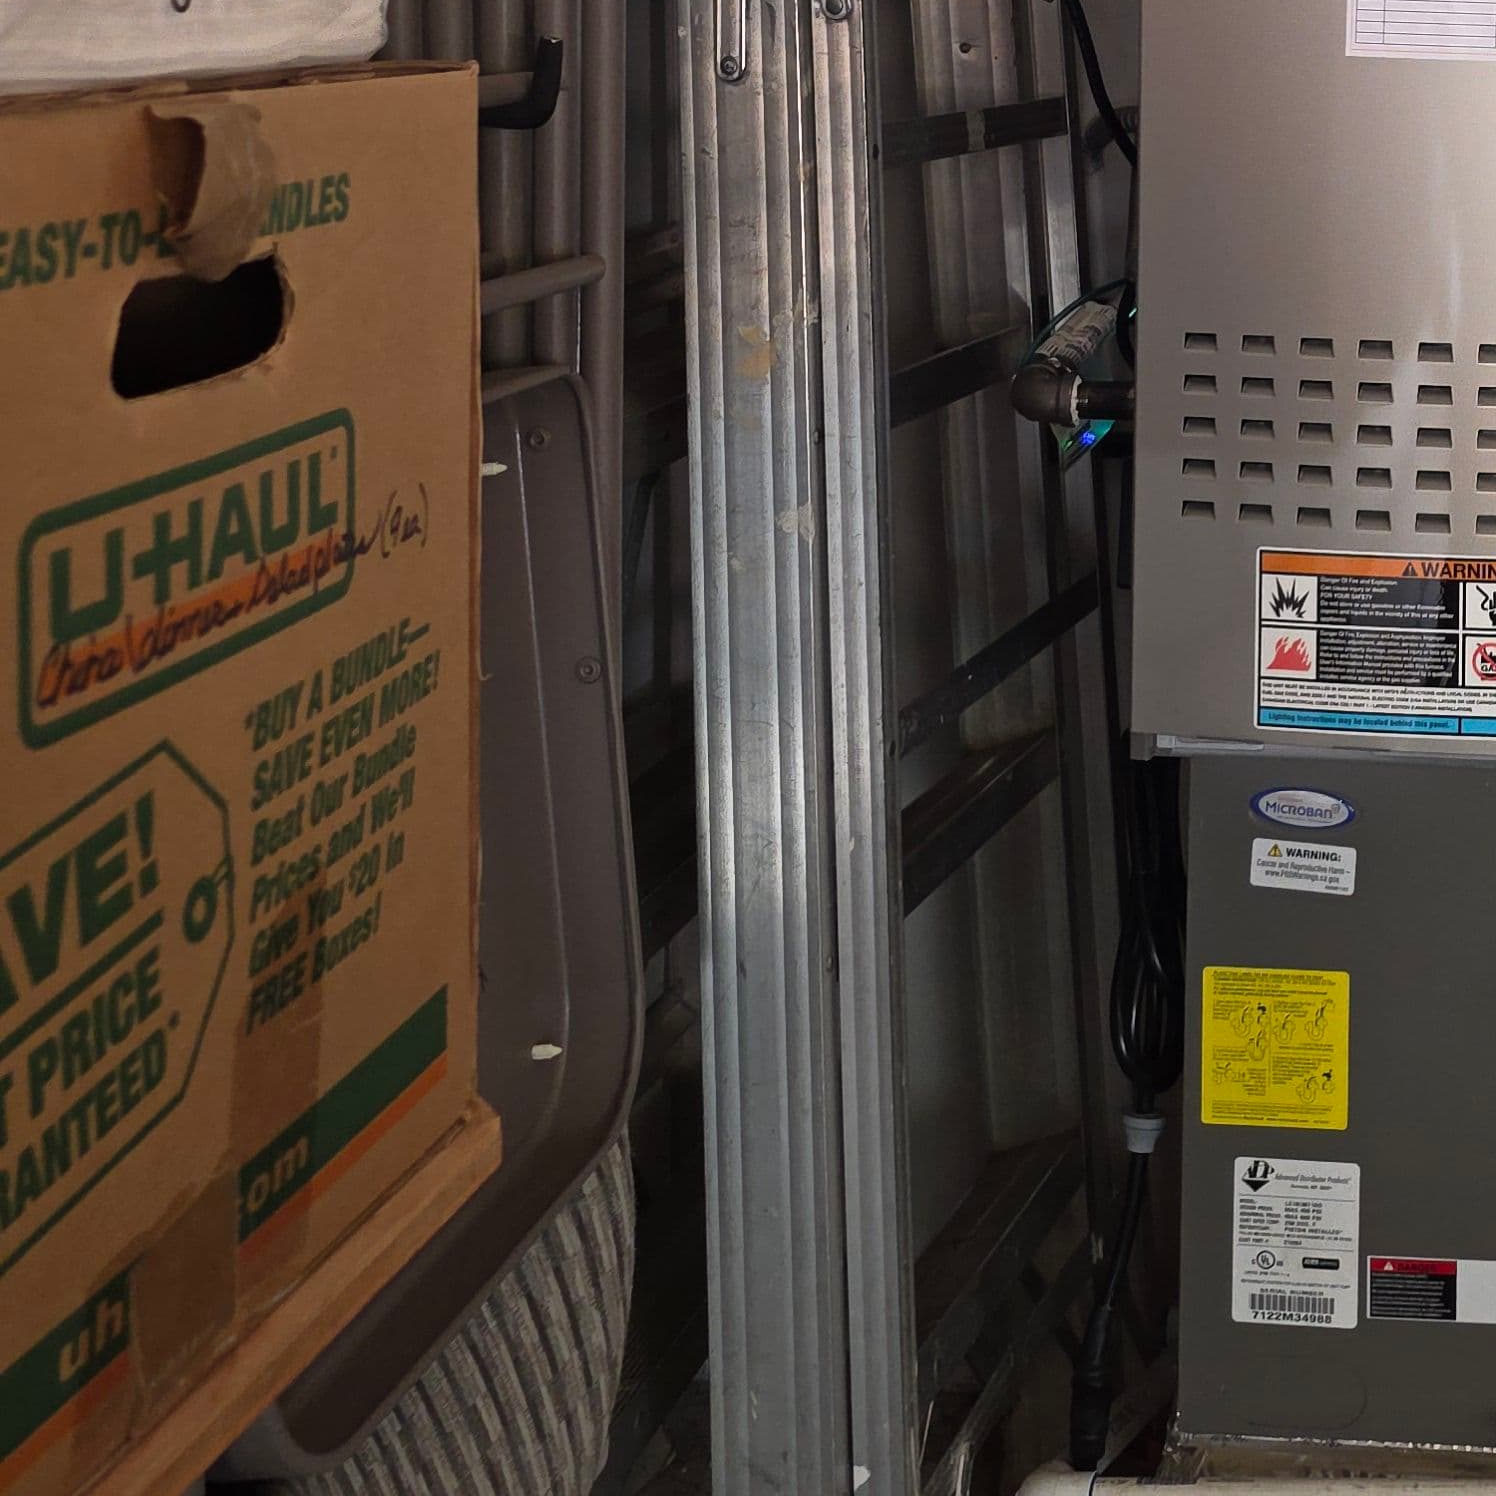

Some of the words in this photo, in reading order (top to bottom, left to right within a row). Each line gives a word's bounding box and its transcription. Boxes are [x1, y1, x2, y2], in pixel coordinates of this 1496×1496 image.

[251, 730, 315, 812] SAVE
[320, 692, 376, 769] EVEN
[378, 648, 441, 729] MORE!
[307, 669, 324, 721] A
[250, 844, 322, 925] Prices
[326, 801, 367, 869] and
[251, 794, 305, 867] Beat
[310, 771, 349, 827] Our
[352, 722, 417, 798] Bundle
[1265, 800, 1333, 819] MICROBAN
[1286, 847, 1342, 862] WARNING:
[246, 951, 309, 1036] FREE
[311, 890, 383, 984] Boxes!
[248, 913, 299, 978] Give
[308, 878, 345, 935] You
[349, 843, 381, 899] $20
[386, 831, 405, 873] in
[26, 944, 164, 1120] PRICE
